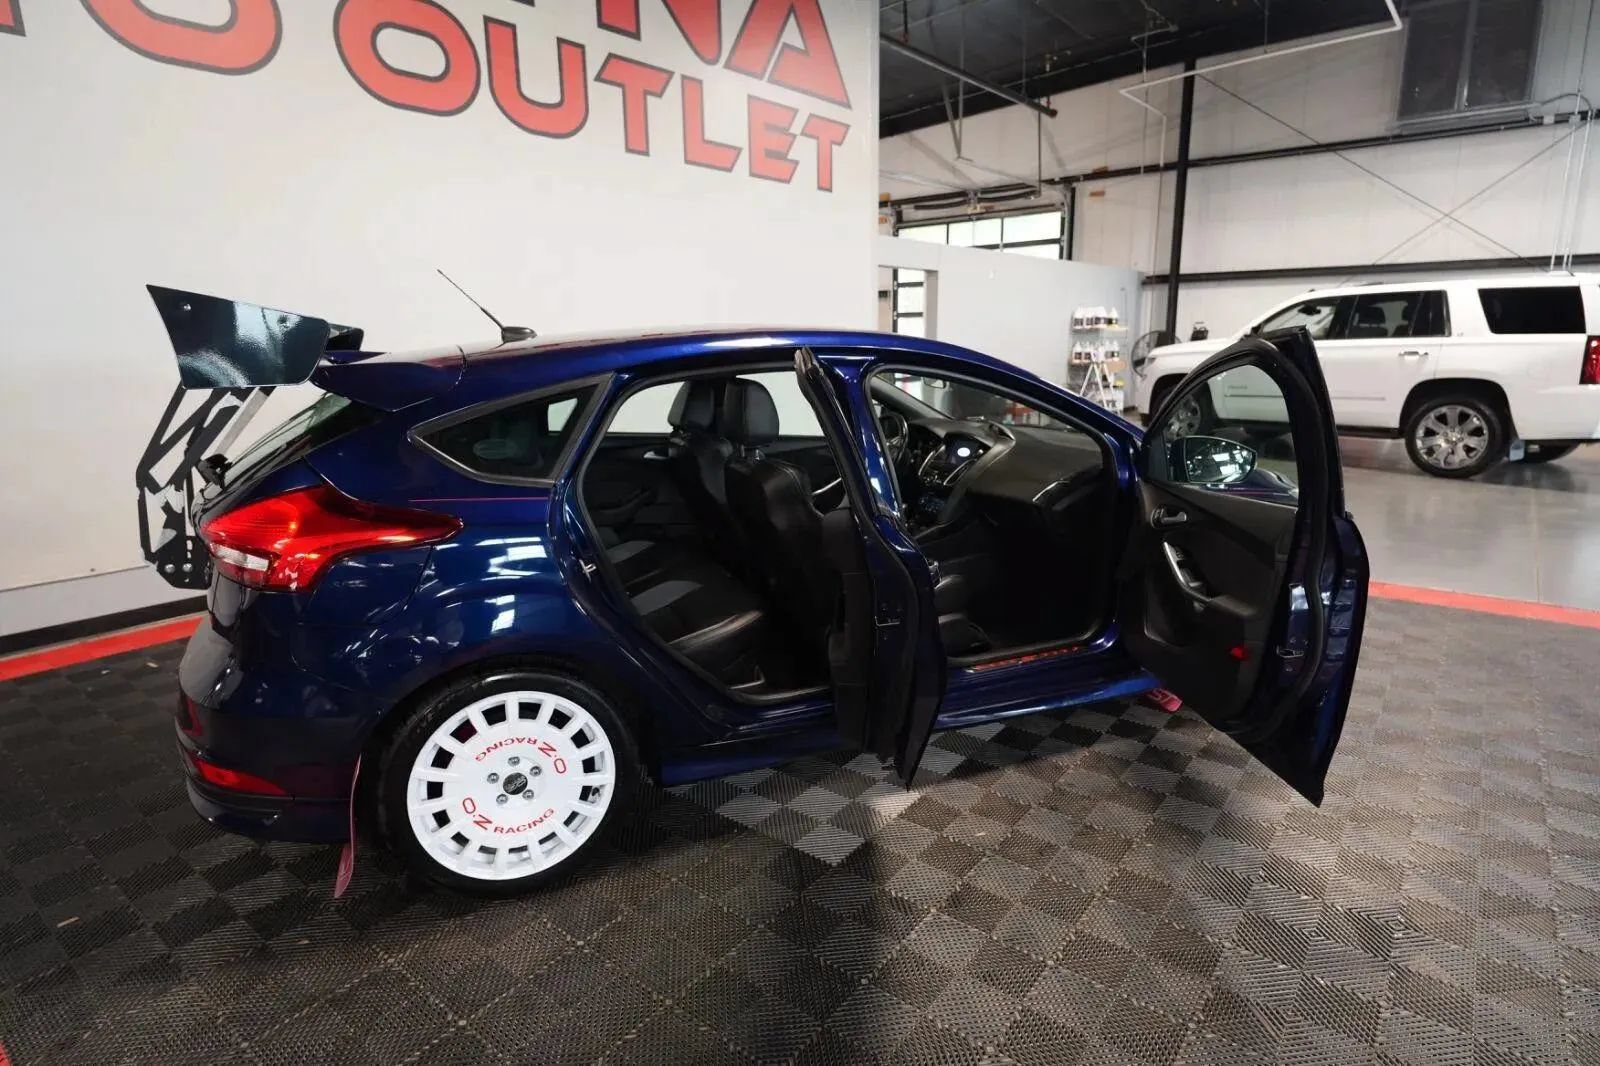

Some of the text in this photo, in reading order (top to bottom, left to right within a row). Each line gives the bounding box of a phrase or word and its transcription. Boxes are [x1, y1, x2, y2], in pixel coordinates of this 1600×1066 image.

[332, 0, 851, 193] OUTLET
[475, 737, 538, 762] RACING
[493, 808, 555, 834] RACING
